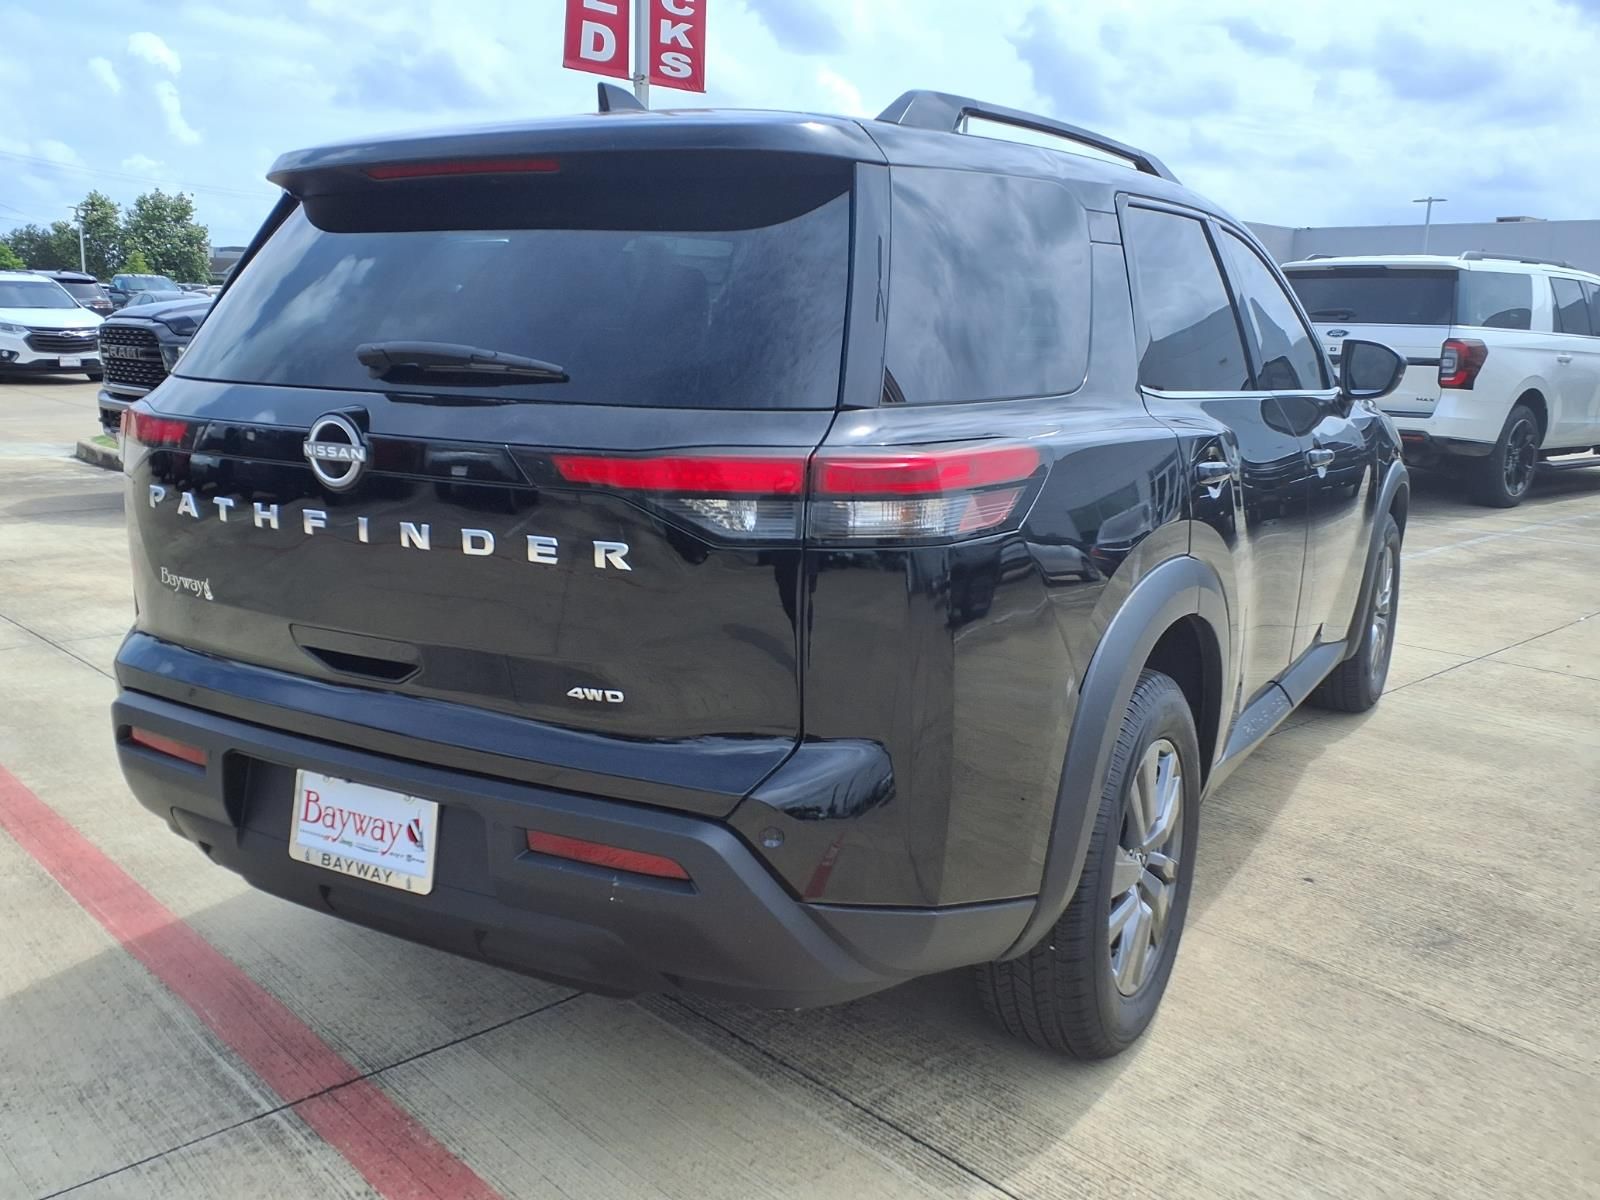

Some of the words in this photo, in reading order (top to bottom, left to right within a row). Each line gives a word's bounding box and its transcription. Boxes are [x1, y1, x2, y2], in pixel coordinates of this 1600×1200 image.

[109, 345, 145, 360] RAM
[304, 441, 365, 461] NISSAN
[149, 484, 632, 571] PATHFINDER
[160, 566, 204, 597] Bayway
[566, 687, 625, 703] 4WD
[301, 789, 403, 856] Bayway
[320, 852, 393, 883] BAYWAY
